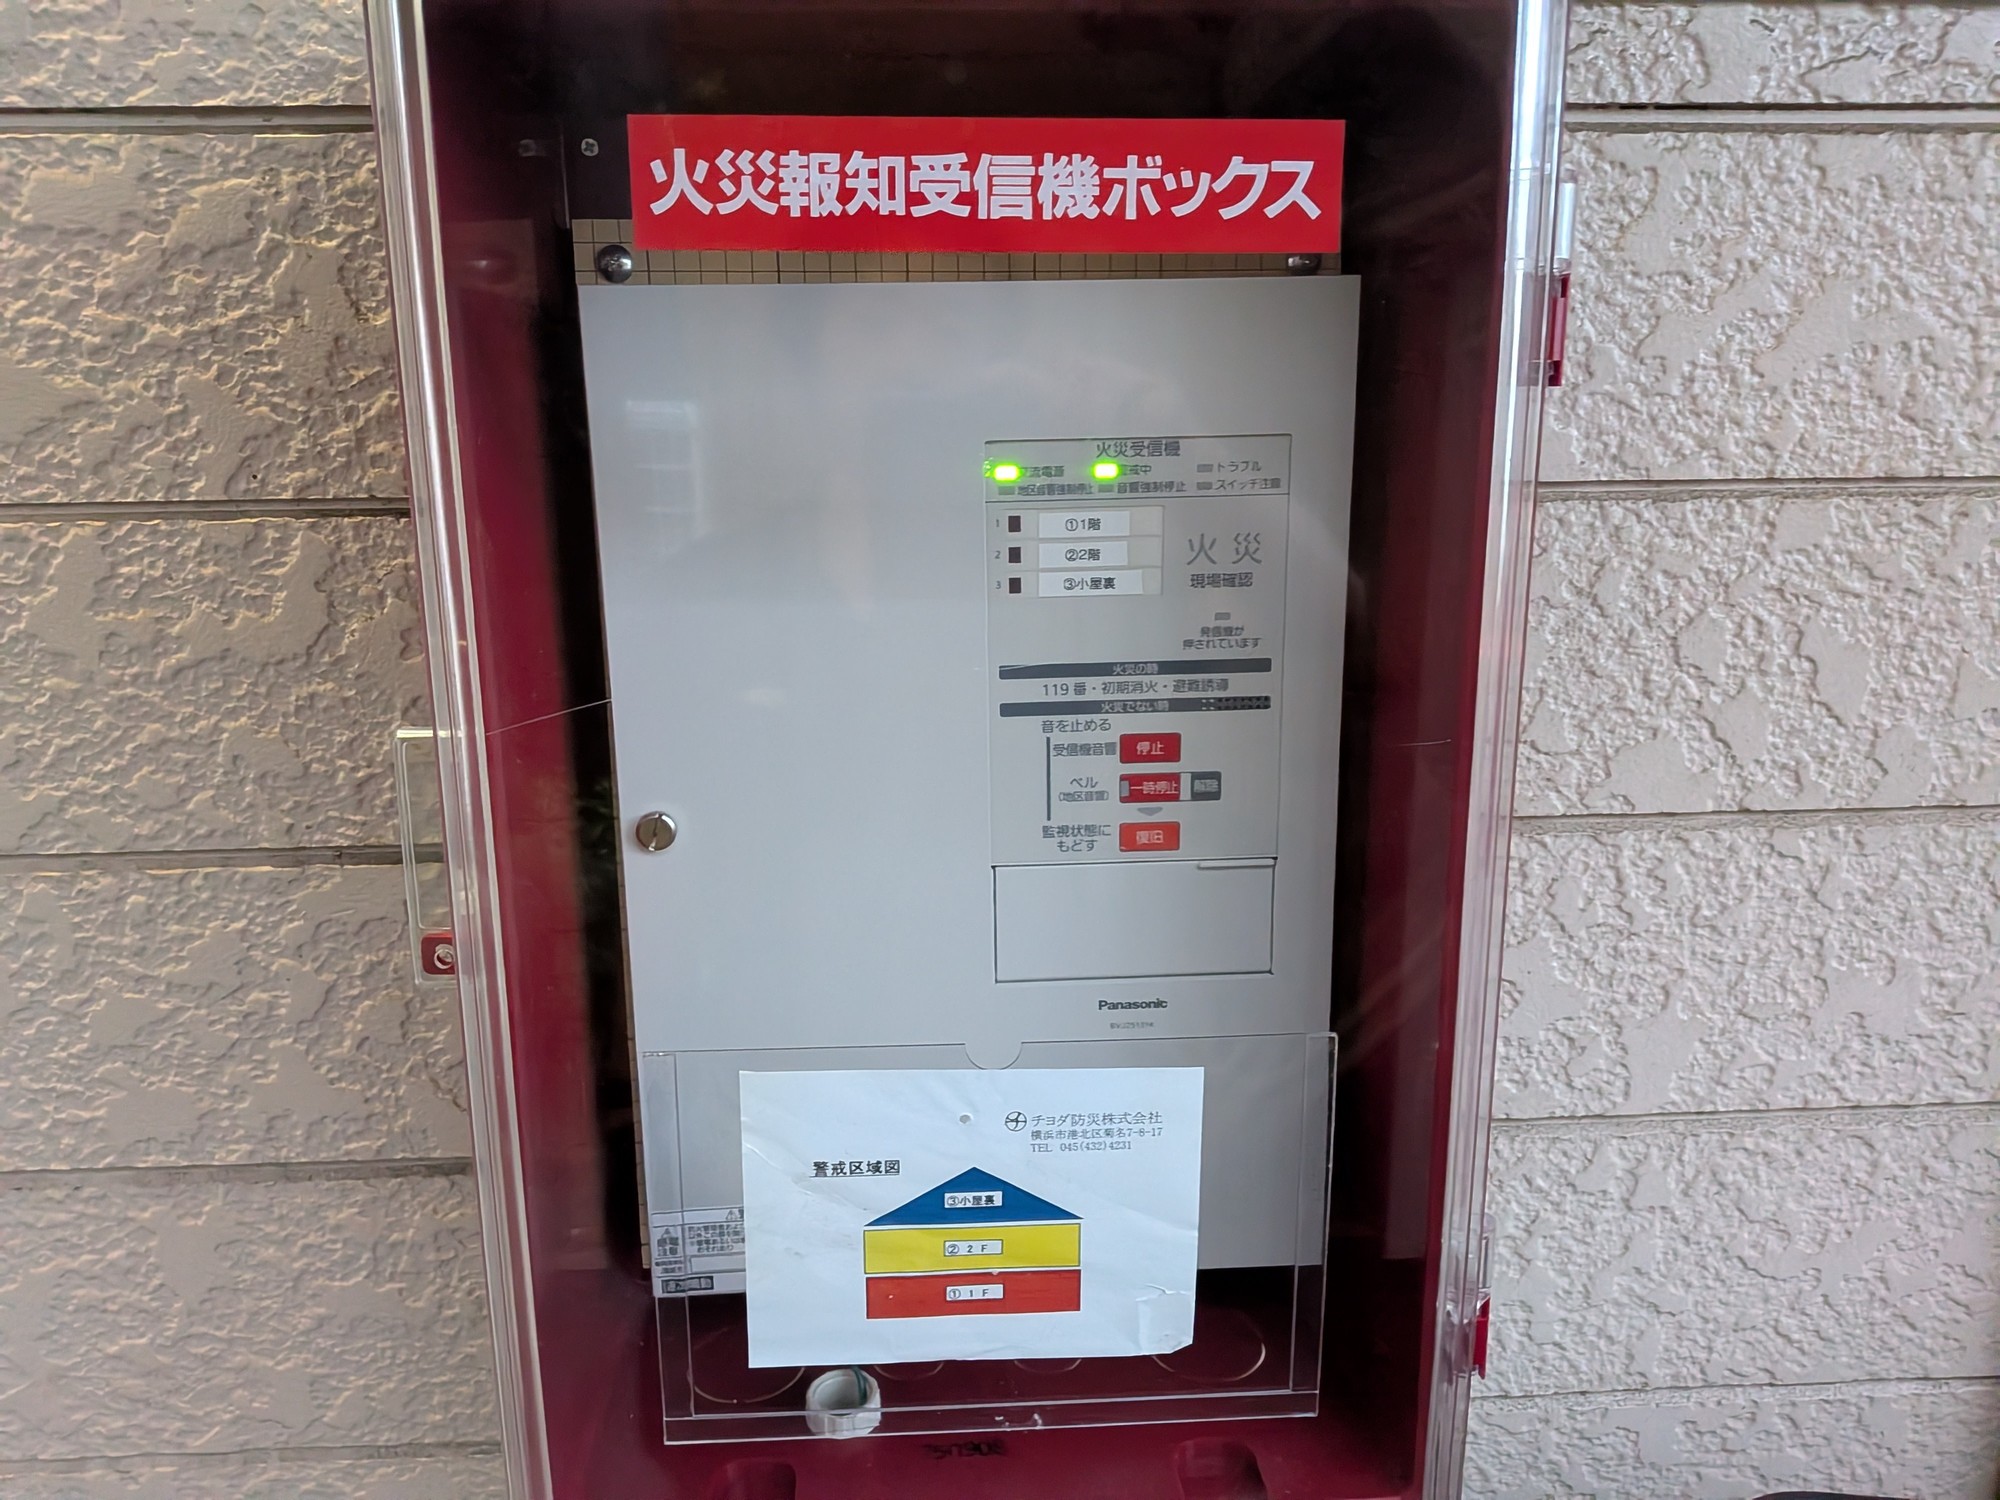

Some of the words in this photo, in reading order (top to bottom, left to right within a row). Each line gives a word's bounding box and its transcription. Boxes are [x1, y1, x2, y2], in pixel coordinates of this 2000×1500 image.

[649, 147, 1322, 220] 火災報知受信機ボックス
[1096, 440, 1181, 458] 火災受信機
[1216, 461, 1262, 473] トラブル
[1190, 572, 1253, 588] 現場確認
[1182, 637, 1262, 650] 押されています
[1041, 718, 1112, 733] 音を止める
[1136, 741, 1165, 756] 停止
[1069, 776, 1099, 788] ベル
[1042, 824, 1112, 839] 監視状態に
[1056, 839, 1098, 853] もどす
[1098, 998, 1168, 1010] Panasonic
[1030, 1143, 1053, 1153] TEL
[1060, 1141, 1132, 1152] 045(432)4231
[812, 1159, 901, 1177] 警戒区域図
